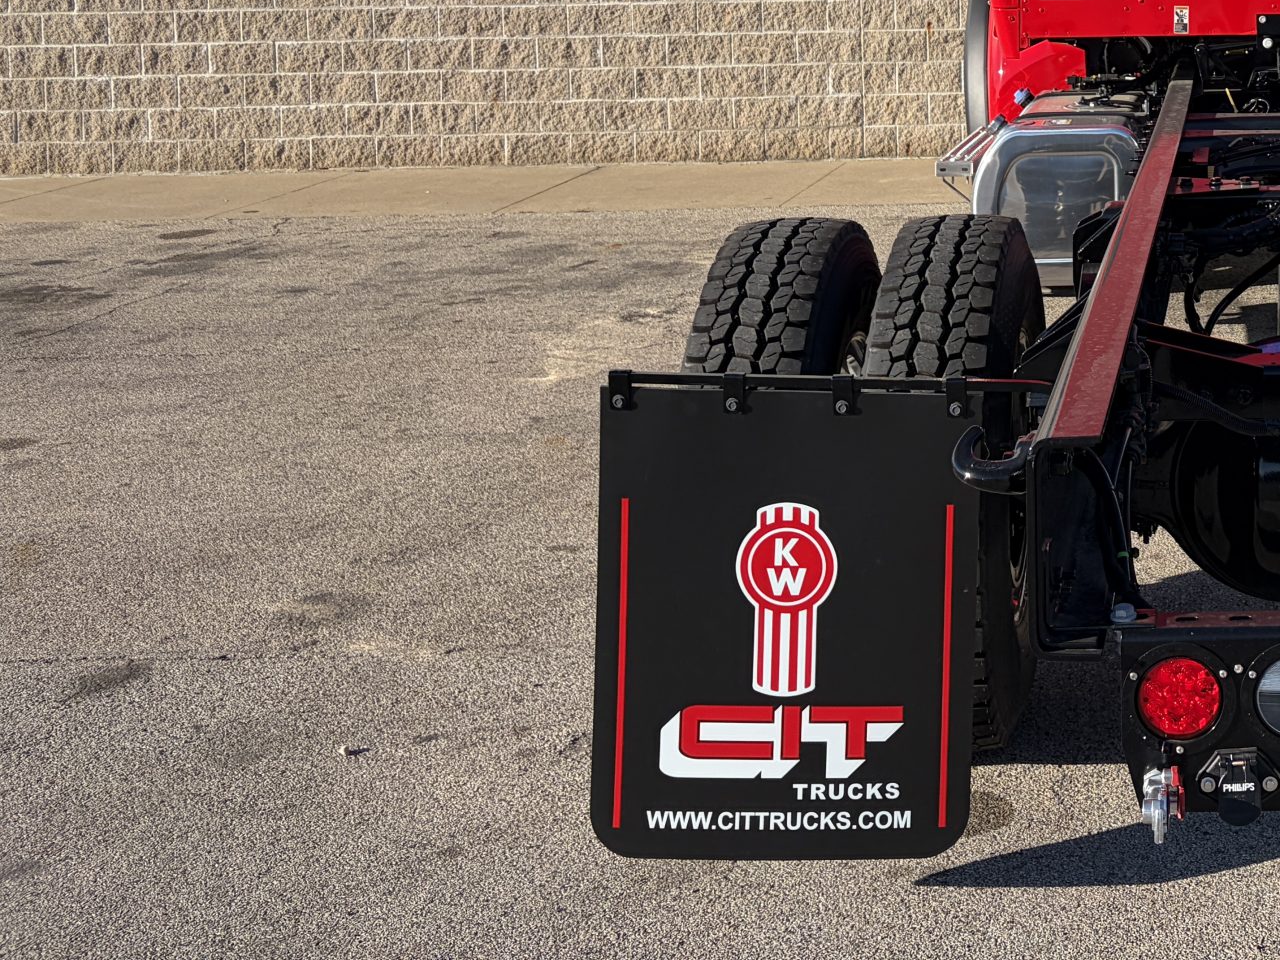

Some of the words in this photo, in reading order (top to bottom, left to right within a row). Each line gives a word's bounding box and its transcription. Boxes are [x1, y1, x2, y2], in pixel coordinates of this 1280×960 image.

[774, 538, 799, 566] K
[766, 568, 807, 596] W
[659, 704, 905, 779] CIT
[793, 783, 900, 800] TRUCKS
[1222, 782, 1255, 792] PHILLIPS
[646, 810, 912, 831] WWW.CITTRUCKS.COM
